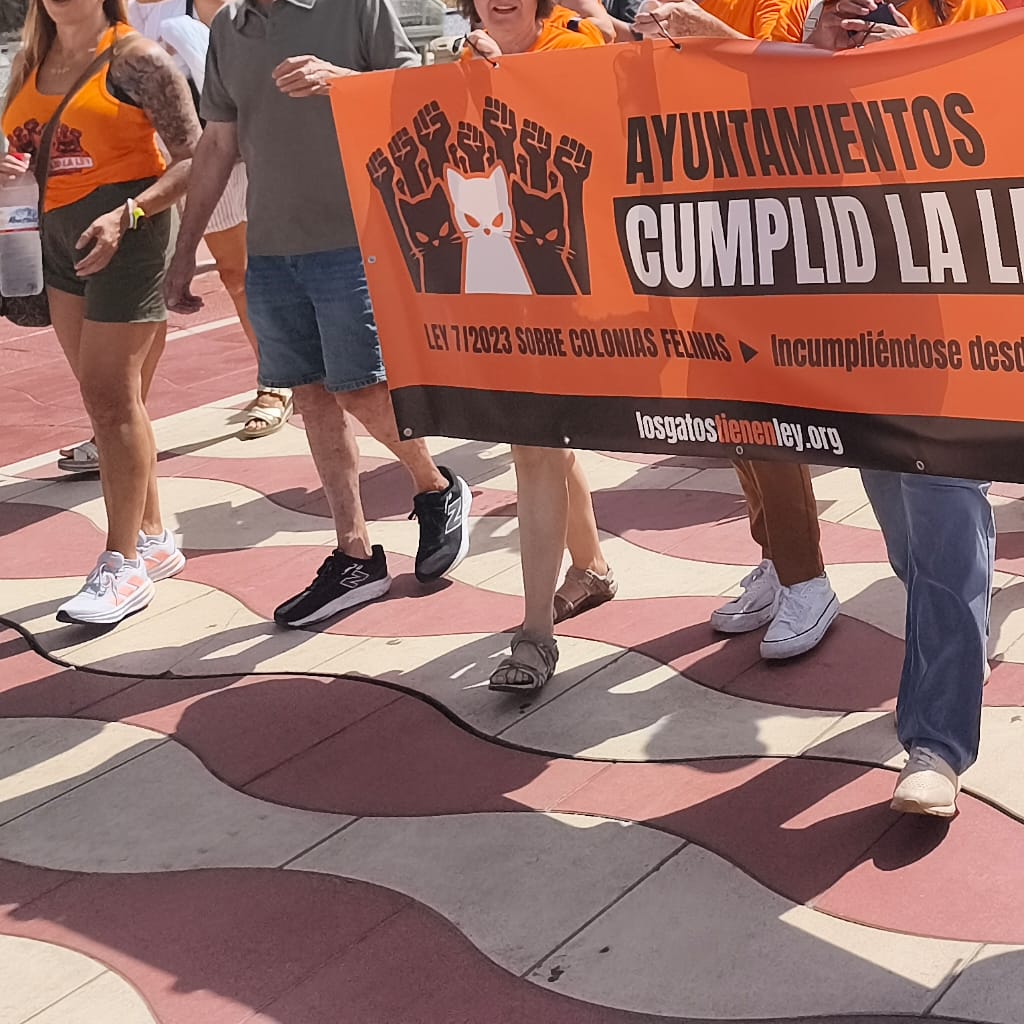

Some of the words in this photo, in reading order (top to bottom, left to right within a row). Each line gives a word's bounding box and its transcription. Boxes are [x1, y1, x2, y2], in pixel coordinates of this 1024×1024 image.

[626, 93, 986, 185] AYUNTAMIENTOS
[625, 195, 877, 288] CUMPLID
[884, 191, 968, 283] LA
[424, 323, 448, 351] LEY
[451, 325, 513, 355] 7/2023
[515, 326, 567, 358] SOBRE
[568, 326, 659, 358] COLONIAS
[660, 328, 732, 362] FELINAS
[771, 330, 963, 372] Incumpliéndose
[635, 411, 844, 455] losgatostienenley.org
